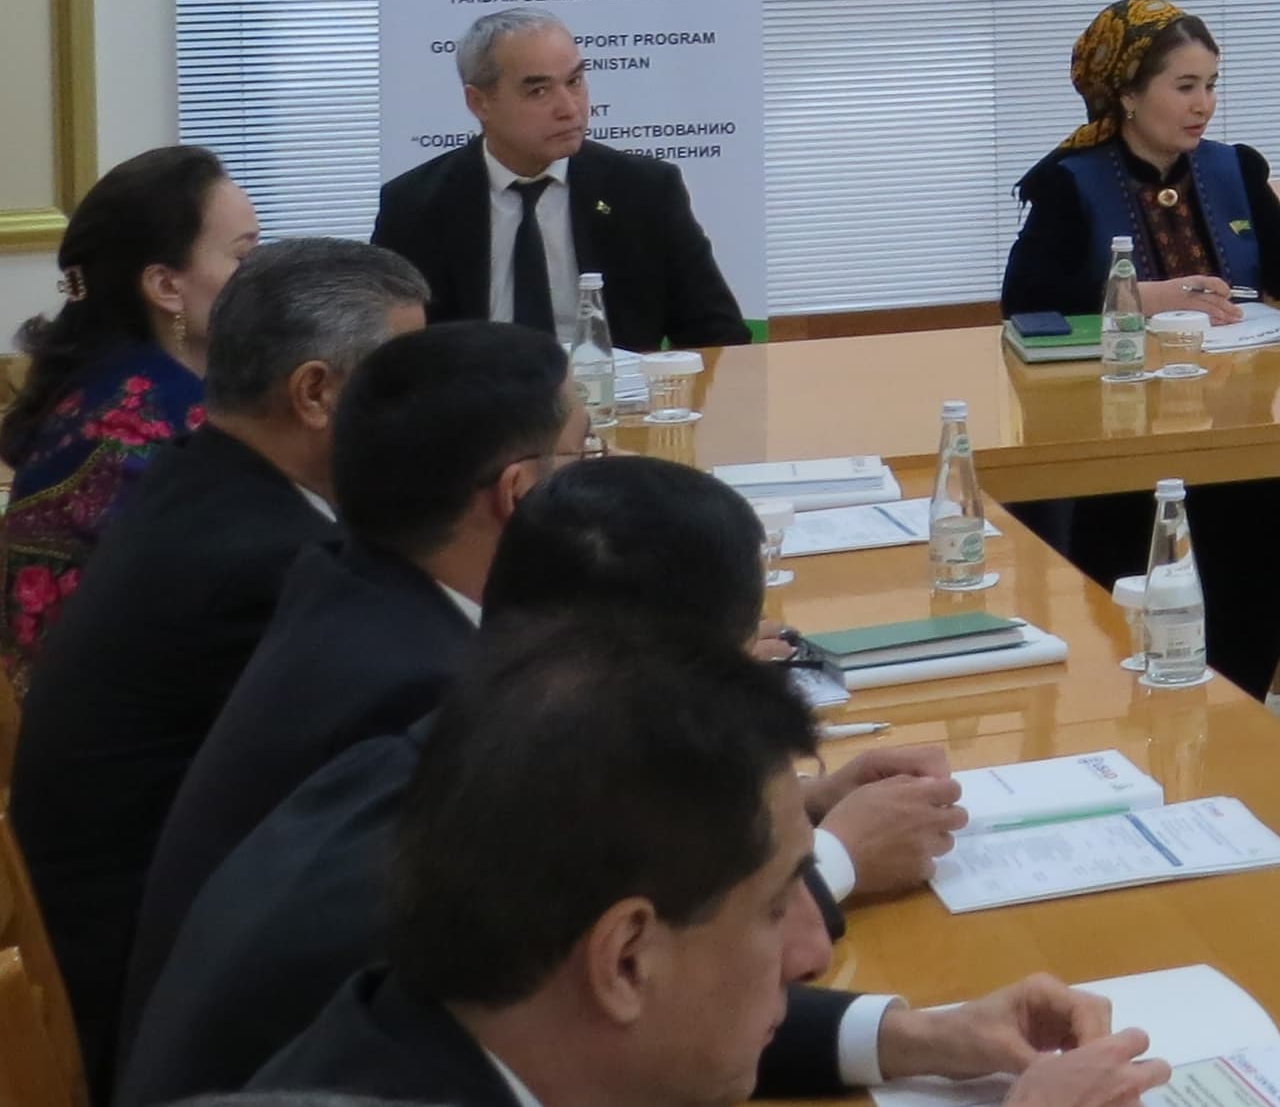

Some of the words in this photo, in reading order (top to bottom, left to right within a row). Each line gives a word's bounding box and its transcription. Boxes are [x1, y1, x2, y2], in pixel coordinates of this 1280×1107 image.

[574, 35, 629, 48] PPORT
[633, 32, 716, 46] PROGRAM
[583, 57, 650, 71] ENISTAN
[584, 122, 736, 140] РШЕНСТВОВАНИЮ
